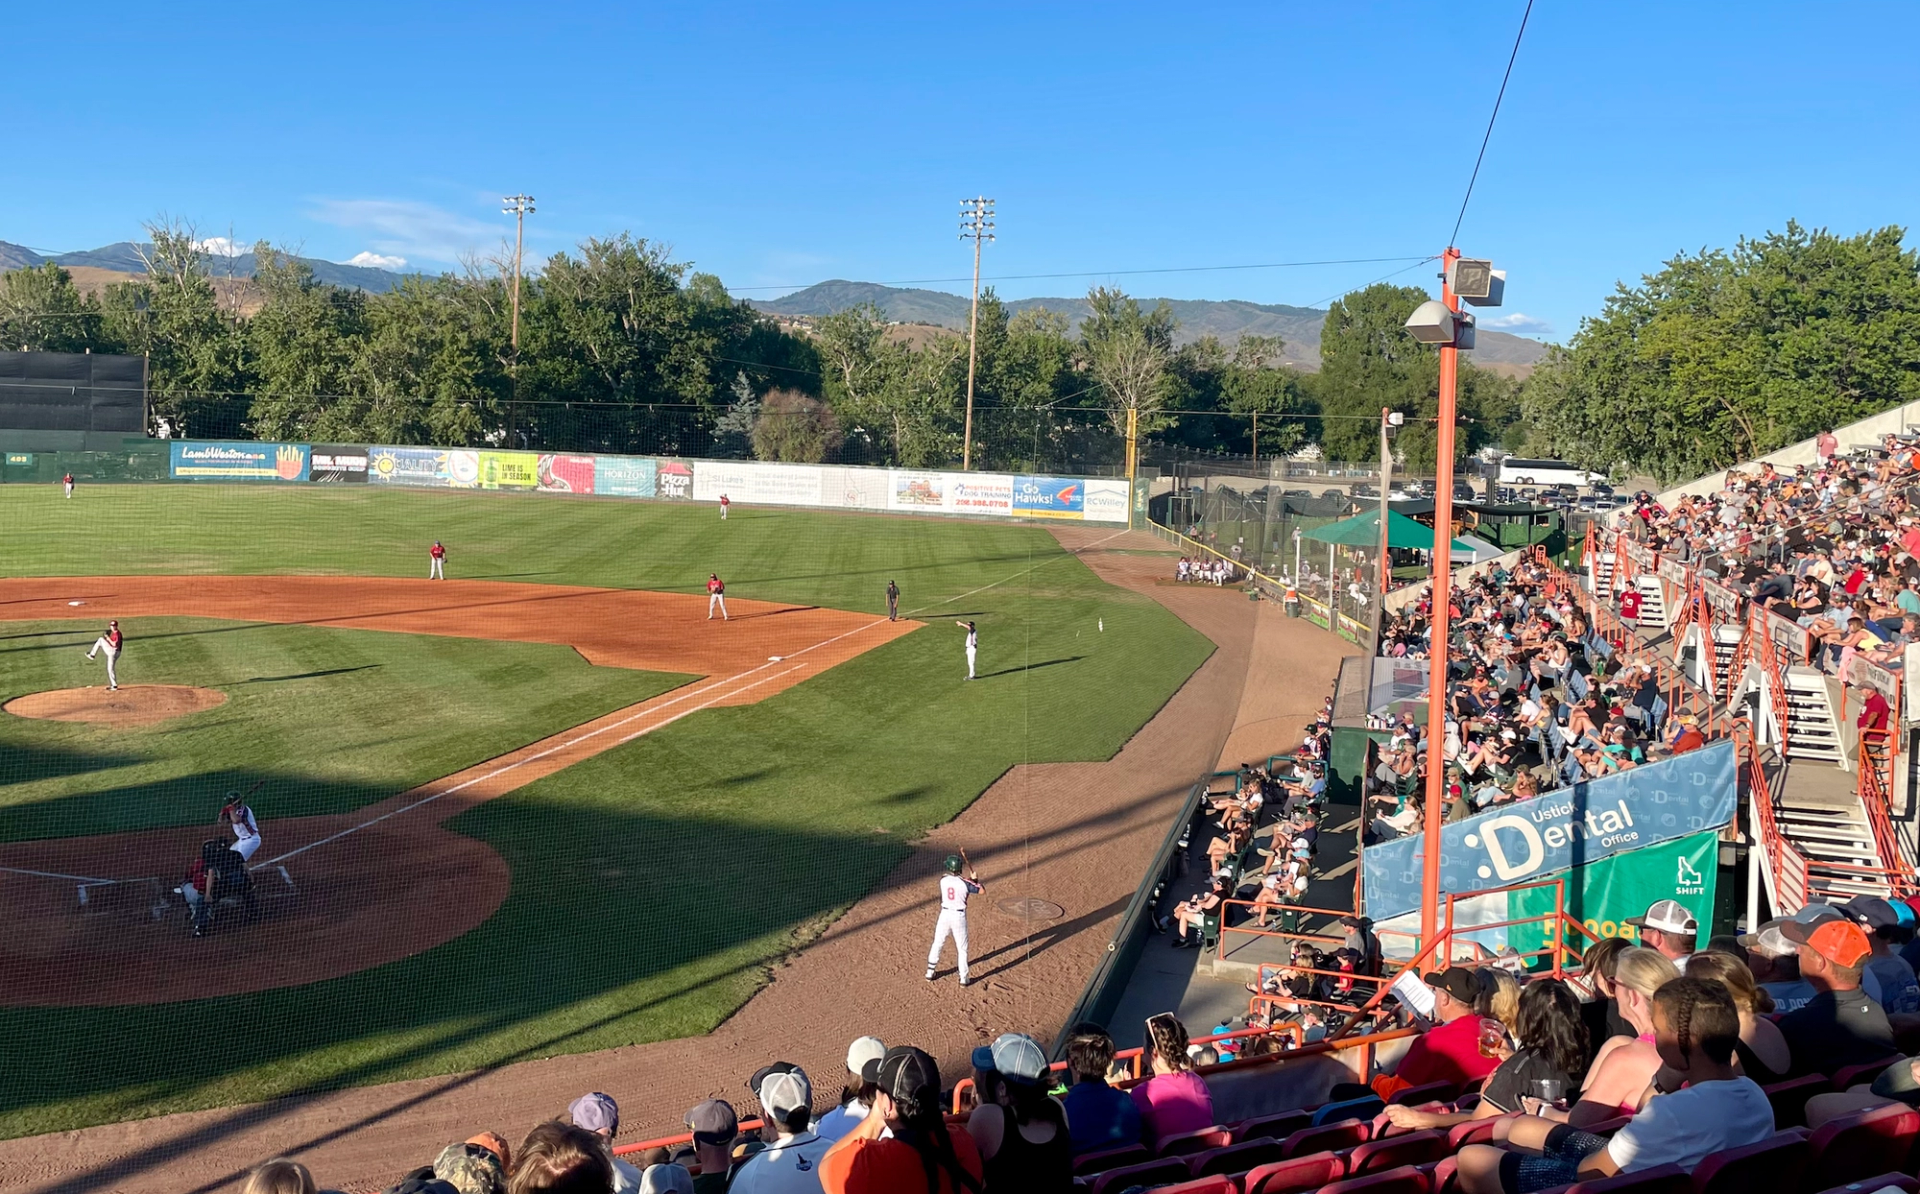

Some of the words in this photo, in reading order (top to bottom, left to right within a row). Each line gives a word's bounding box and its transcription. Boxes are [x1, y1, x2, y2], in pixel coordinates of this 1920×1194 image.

[509, 473, 531, 481] SEASON
[604, 470, 646, 480] HORIZON
[660, 473, 690, 485] Pizza
[660, 485, 684, 498] Hut
[1022, 483, 1039, 494] Go
[980, 491, 1011, 499] TRAINING
[1015, 492, 1053, 504] Hawks!
[1531, 801, 1578, 823] Ustick
[1601, 831, 1639, 848] Office
[947, 887, 955, 900] 8
[1676, 887, 1704, 895] SHIFT
